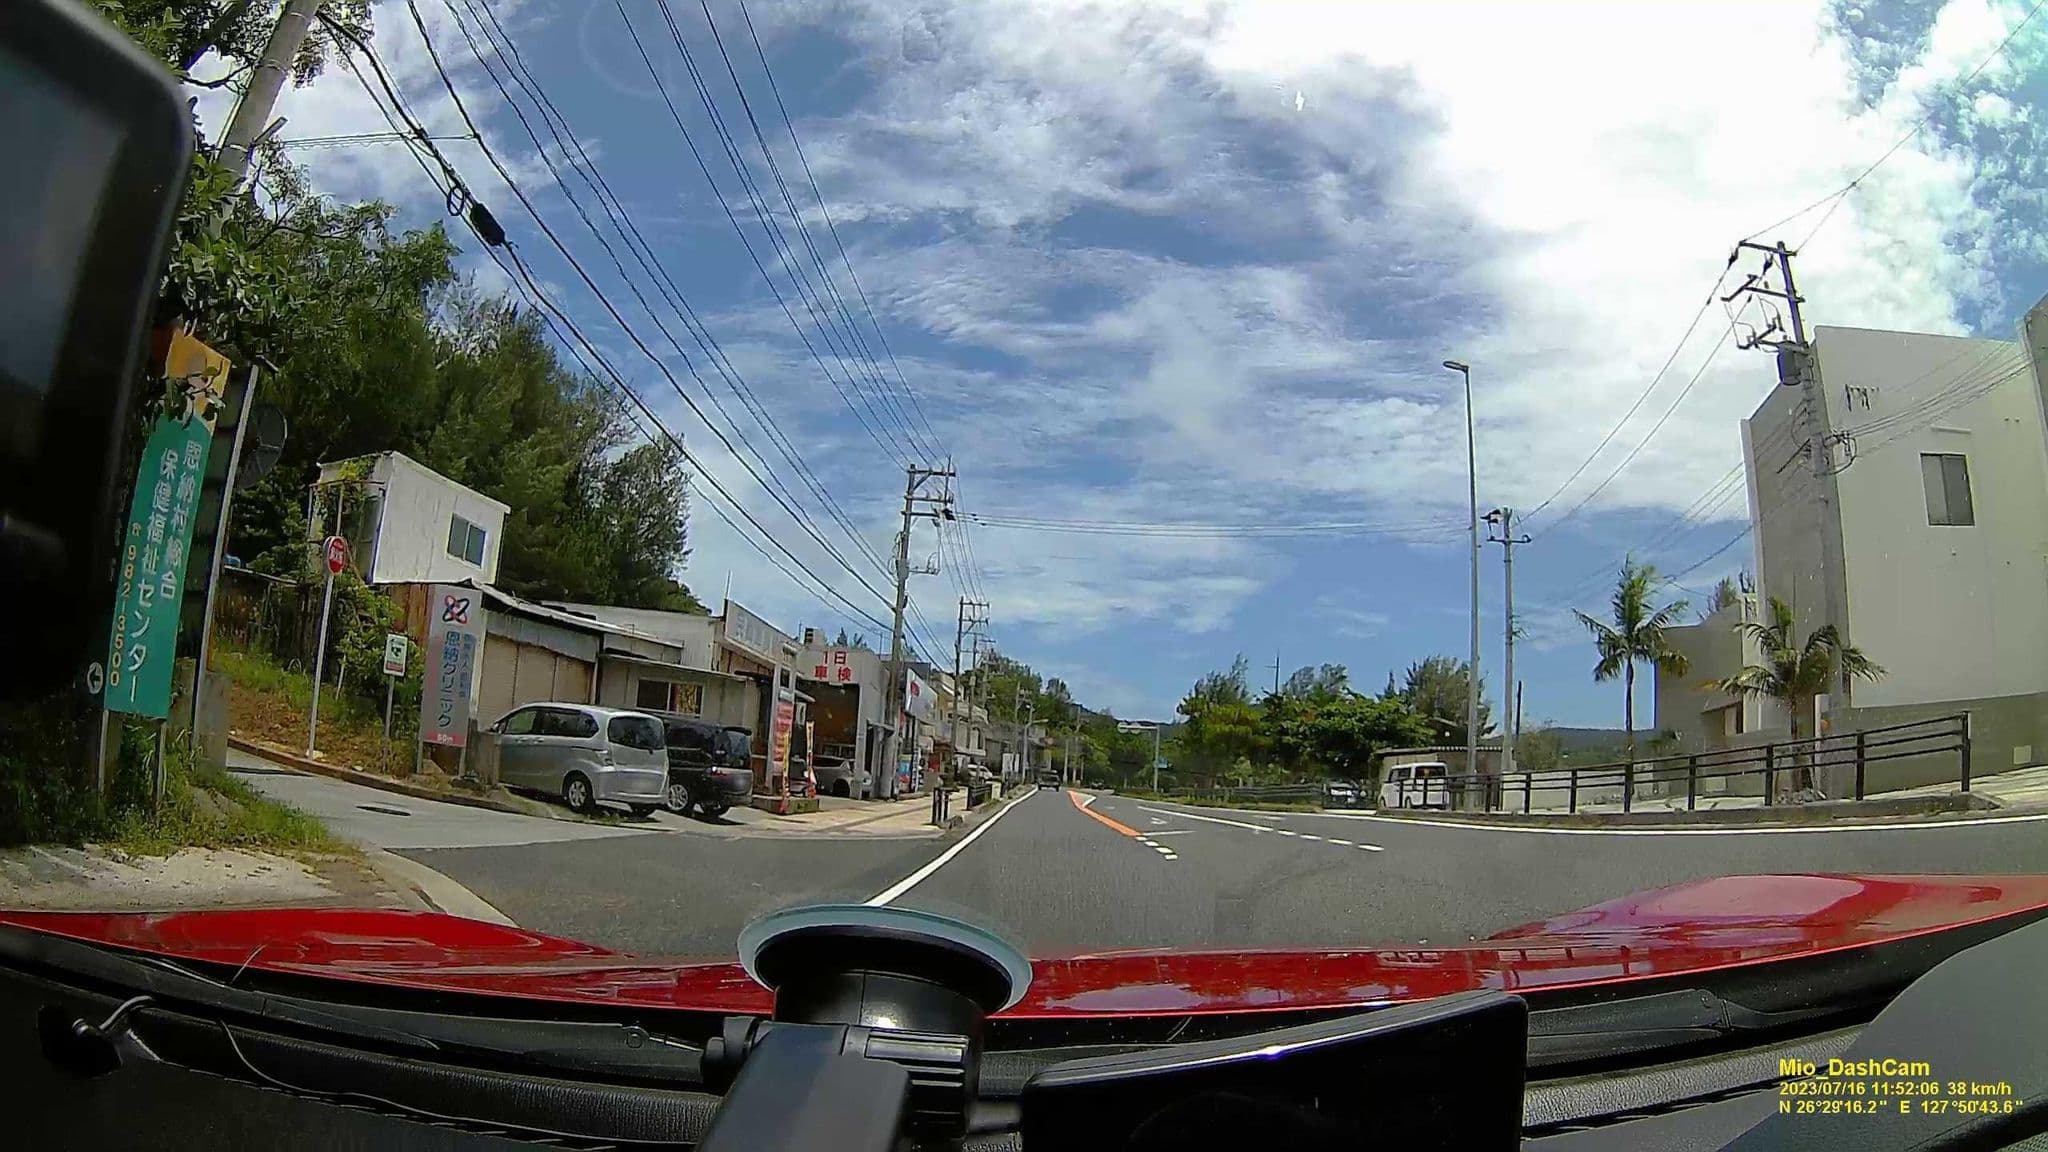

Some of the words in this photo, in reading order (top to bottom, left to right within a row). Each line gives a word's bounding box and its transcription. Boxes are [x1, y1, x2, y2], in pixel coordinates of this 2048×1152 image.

[127, 447, 179, 703] 保健福祉センター
[160, 440, 203, 600] 恩納村総合
